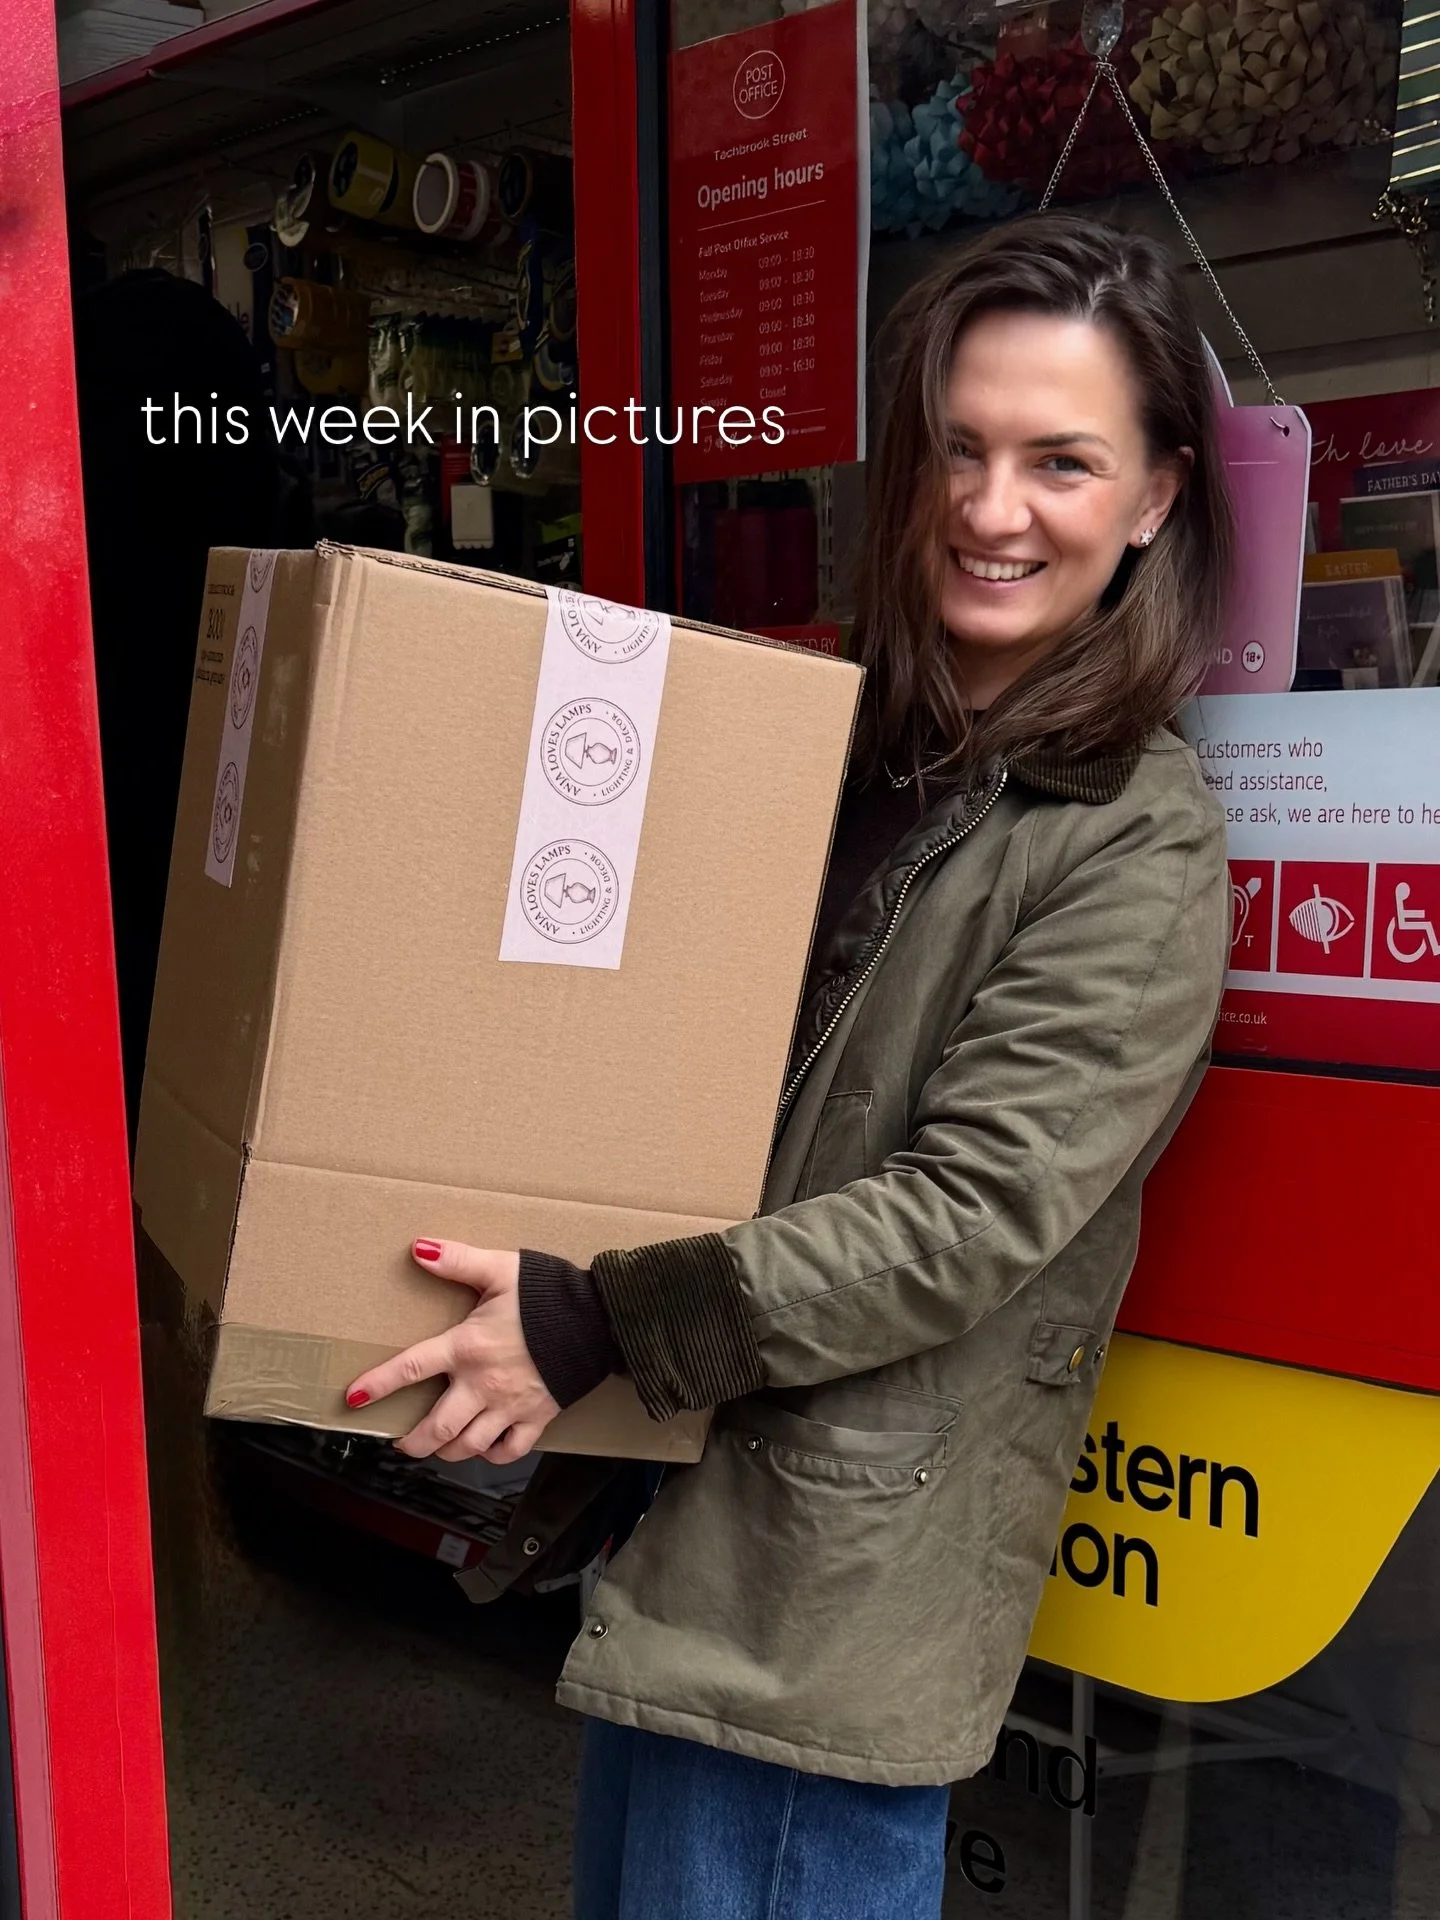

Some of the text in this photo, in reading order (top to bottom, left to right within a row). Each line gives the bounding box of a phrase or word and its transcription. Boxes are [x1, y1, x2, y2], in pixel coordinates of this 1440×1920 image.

[745, 64, 774, 84] POST
[739, 80, 778, 104] OFFICE
[772, 128, 808, 147] Street
[697, 162, 824, 211] Opening hours
[714, 242, 732, 255] Post
[759, 230, 790, 245] Service
[1359, 432, 1433, 459] love
[1367, 474, 1418, 492] FATHER'S
[575, 627, 602, 653] ANJA
[547, 704, 592, 796] ANJA LOVES LAMPS
[1197, 737, 1323, 759] Customers who
[601, 760, 633, 796] LIGHTING
[1239, 771, 1328, 793] assistance,
[1249, 802, 1281, 826] ask,
[1287, 807, 1311, 823] we
[1317, 808, 1345, 824] are
[1351, 802, 1391, 824] here
[1397, 804, 1414, 824] to
[527, 845, 570, 935] ANJA LOVES LAMPS
[580, 897, 611, 934] LIGHTING
[1049, 1522, 1159, 1607] on
